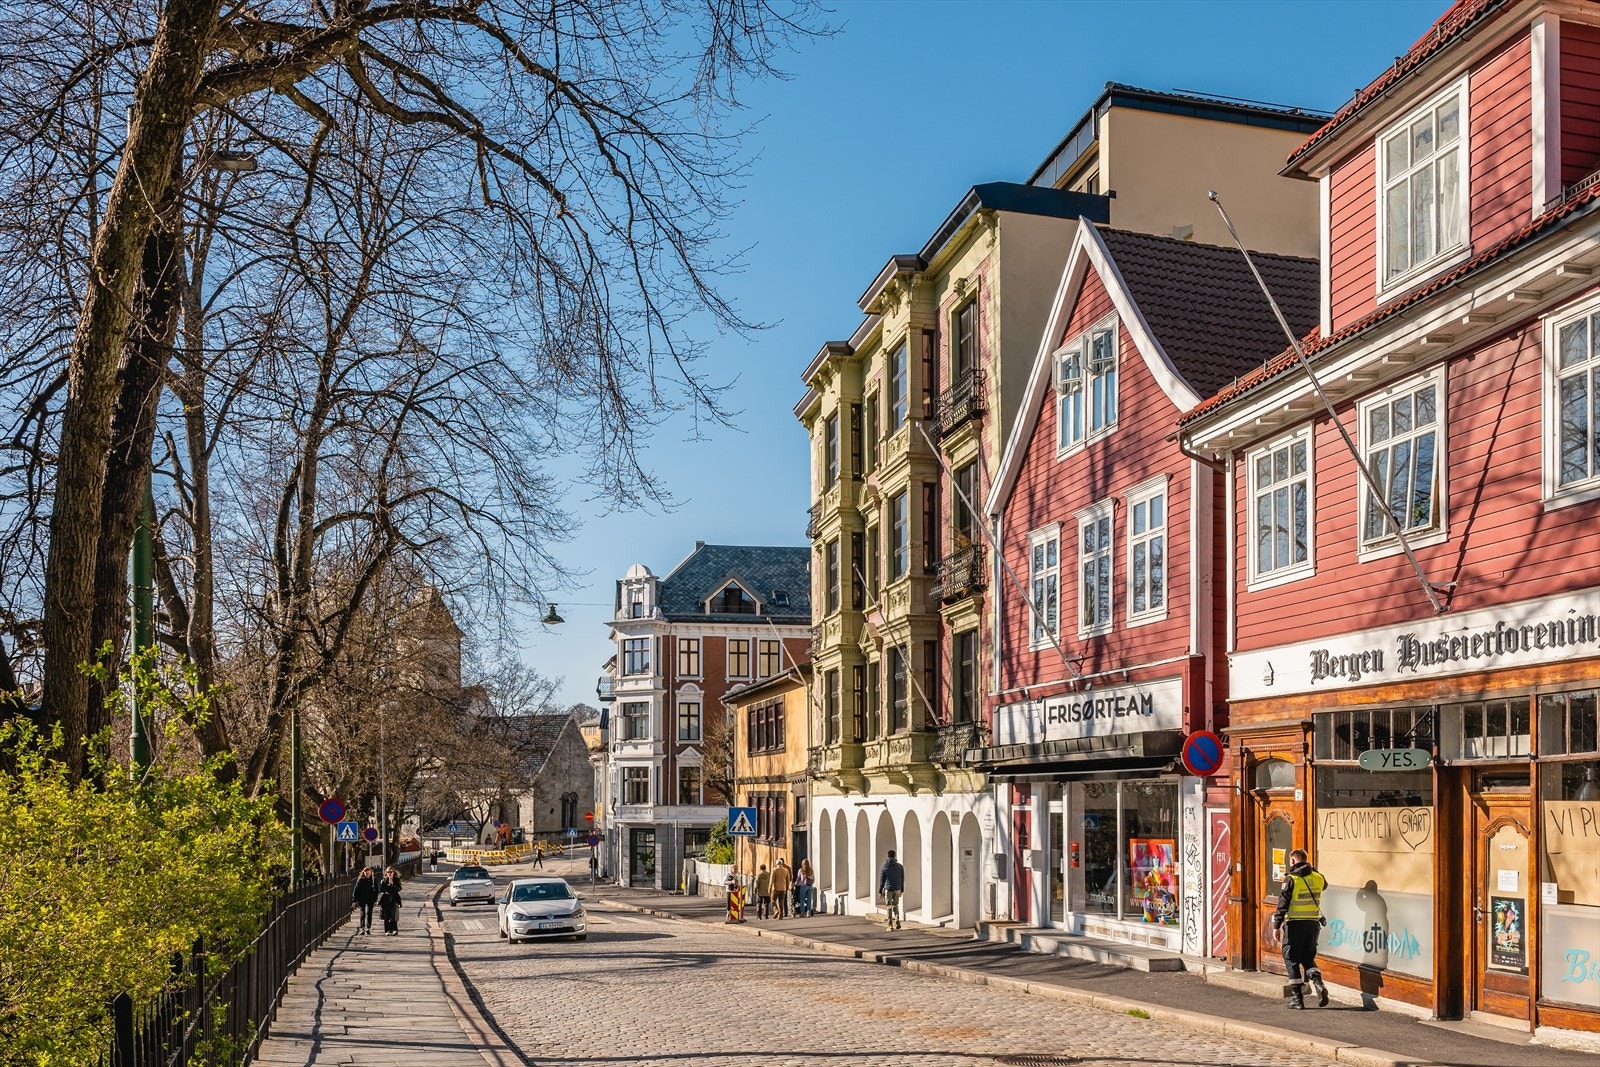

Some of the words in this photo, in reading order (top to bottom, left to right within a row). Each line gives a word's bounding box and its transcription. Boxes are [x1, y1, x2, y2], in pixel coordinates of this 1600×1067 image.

[1310, 648, 1384, 685] Bergen
[1048, 692, 1153, 725] FRISØRTEAM
[1381, 752, 1417, 768] YES.
[1317, 811, 1392, 840] VELKOMMEN
[1401, 813, 1428, 835] SNART
[1550, 807, 1575, 837] VI
